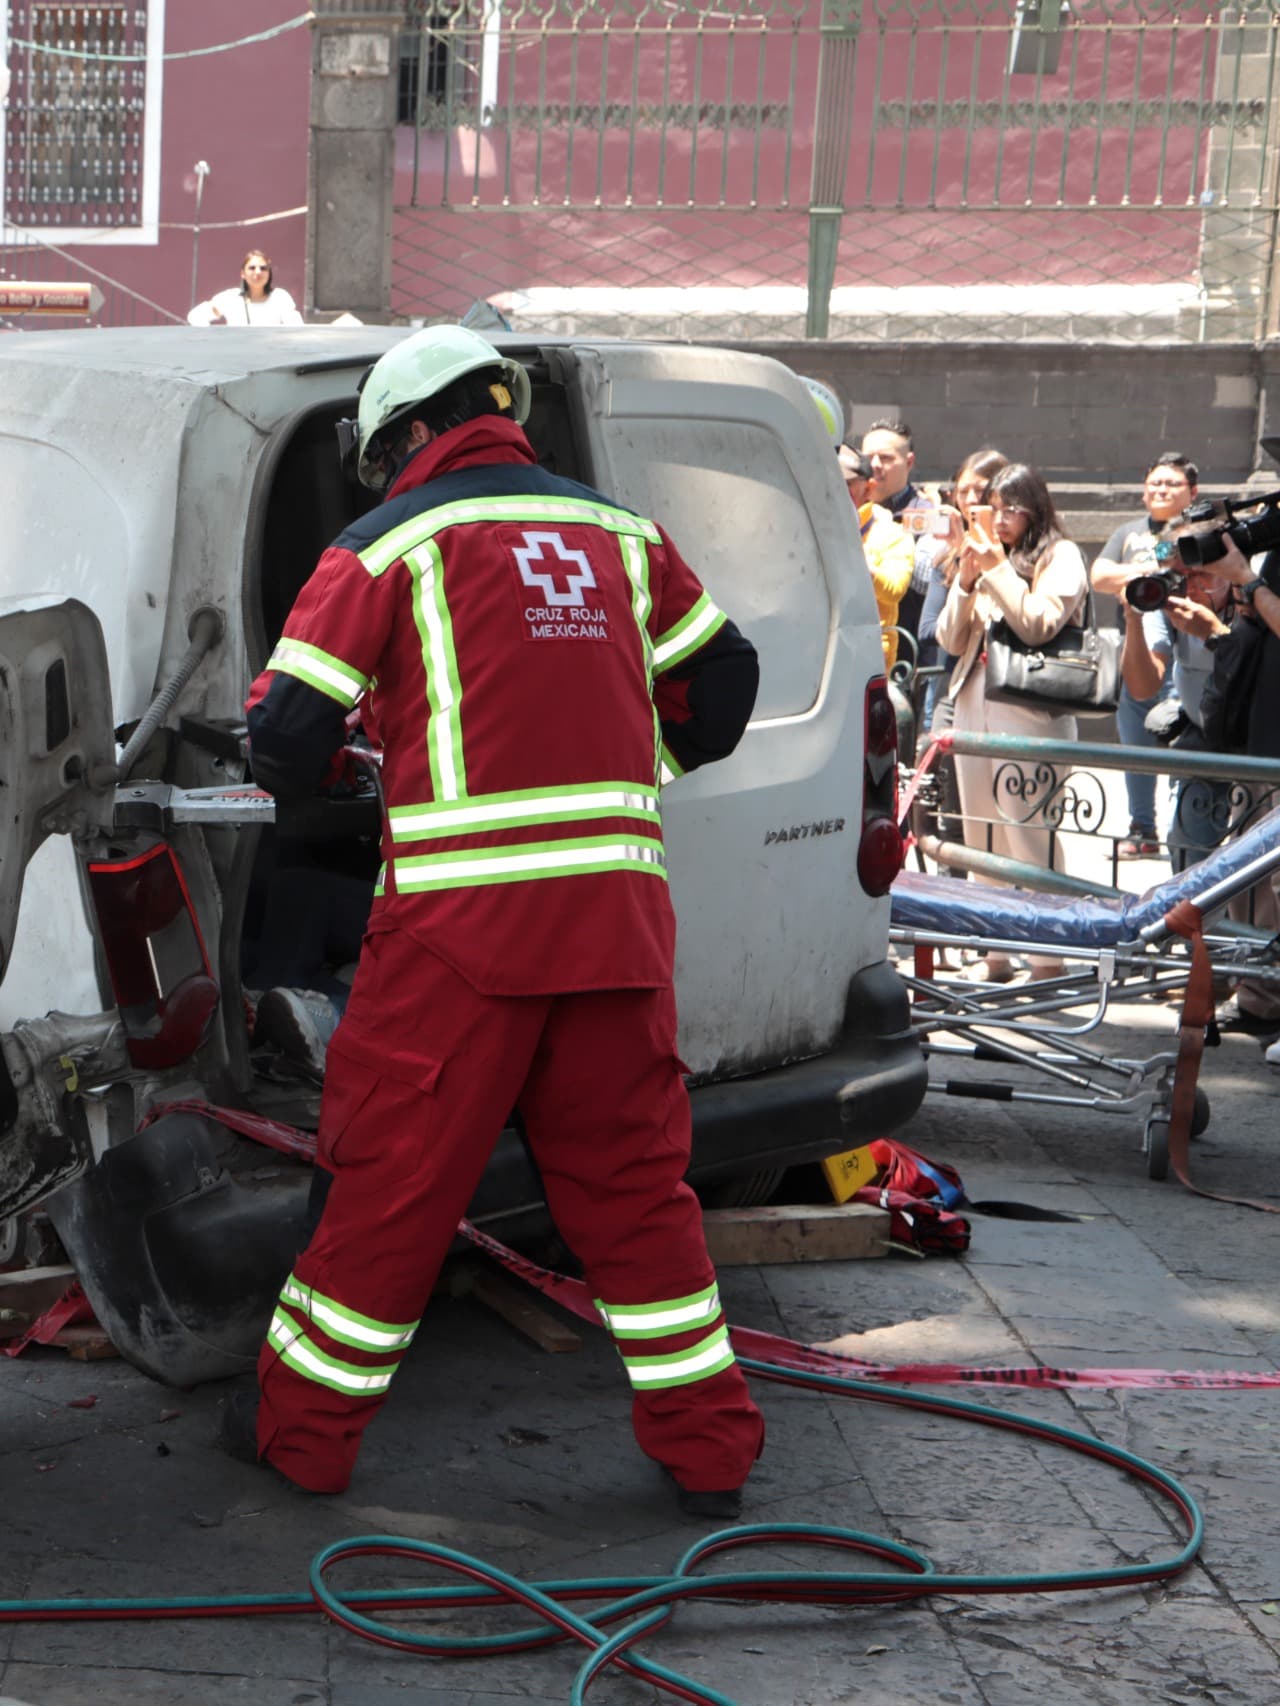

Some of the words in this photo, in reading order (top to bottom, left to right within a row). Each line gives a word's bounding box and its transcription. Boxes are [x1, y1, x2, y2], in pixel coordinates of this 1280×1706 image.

[524, 607, 565, 622] CRUZ
[569, 607, 608, 623] ROJA
[531, 623, 608, 639] MEXICANA
[764, 818, 846, 846] PARTNER
